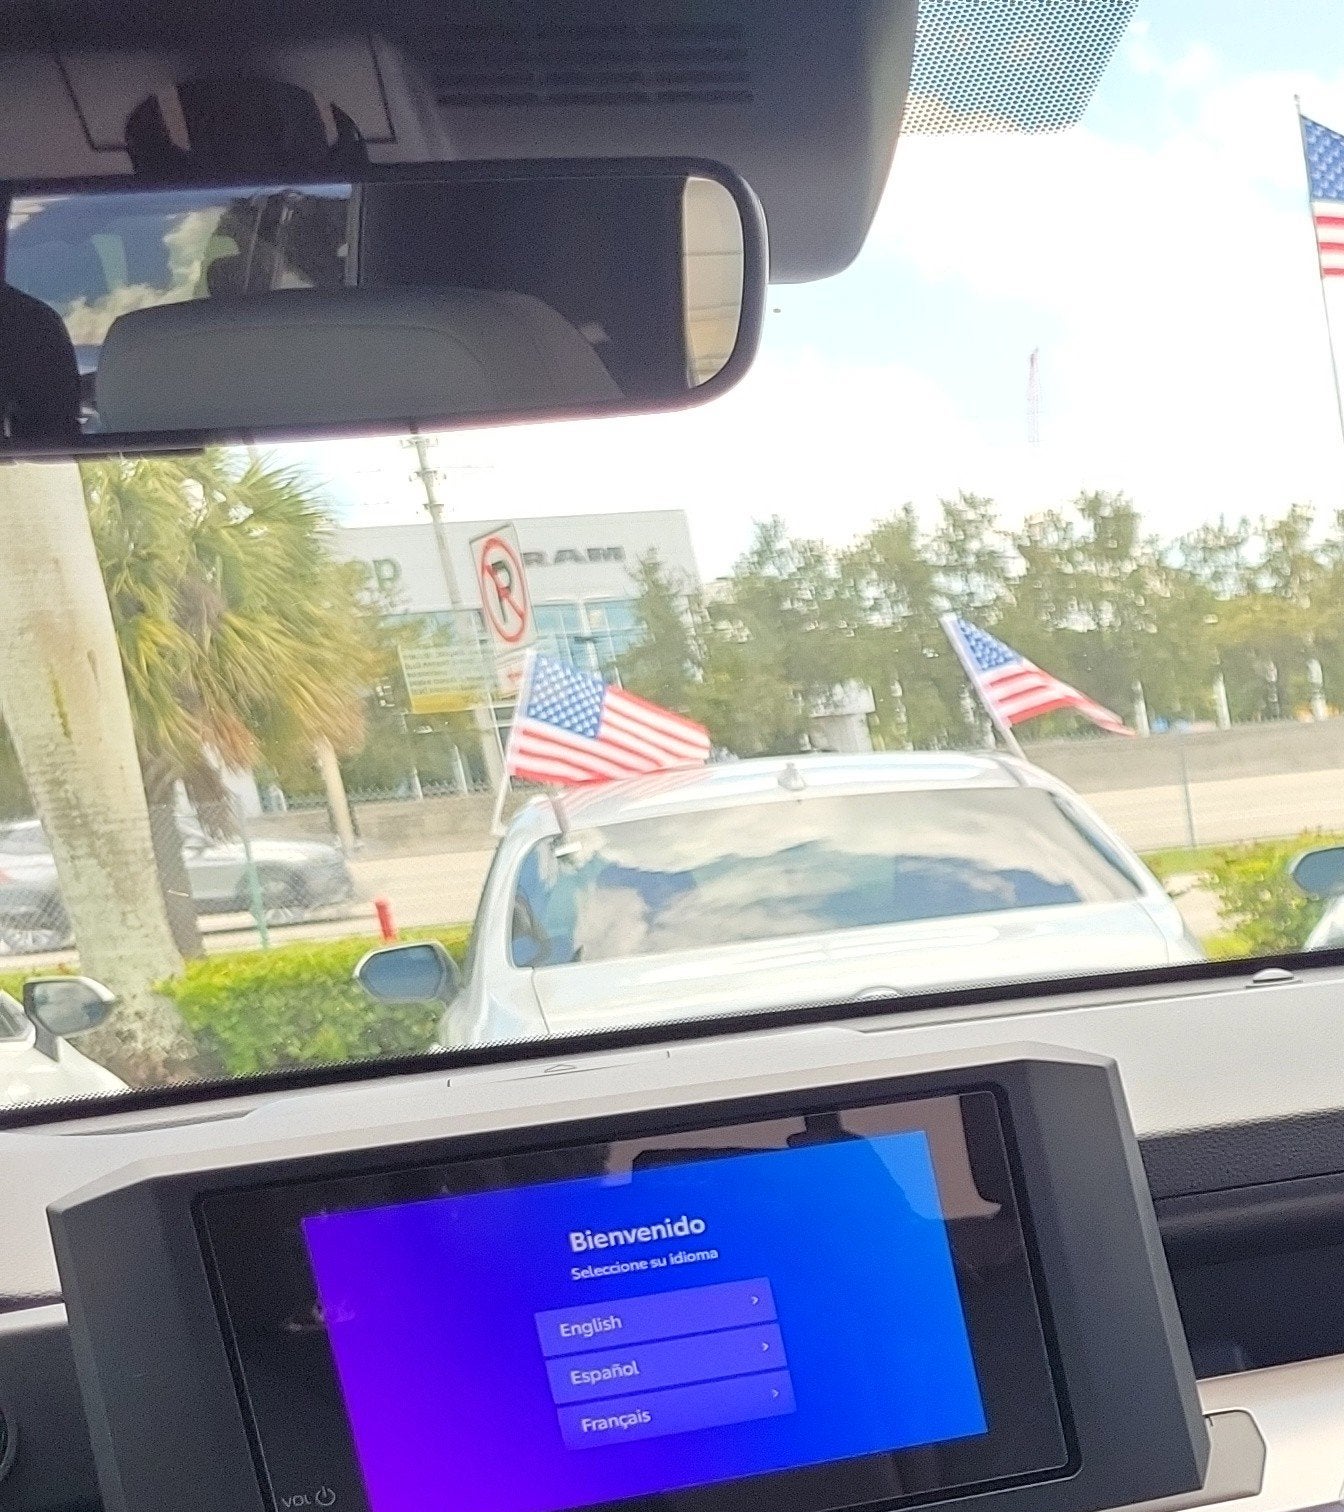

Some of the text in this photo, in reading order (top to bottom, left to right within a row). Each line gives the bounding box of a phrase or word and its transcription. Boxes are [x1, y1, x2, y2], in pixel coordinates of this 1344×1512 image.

[521, 545, 626, 567] RAM
[568, 1215, 707, 1253] Bienvenido
[570, 1249, 719, 1281] Seleccione su idioma
[559, 1315, 623, 1338] English
[570, 1360, 640, 1386] Español
[580, 1409, 652, 1433] Français
[281, 1494, 312, 1508] VOL
